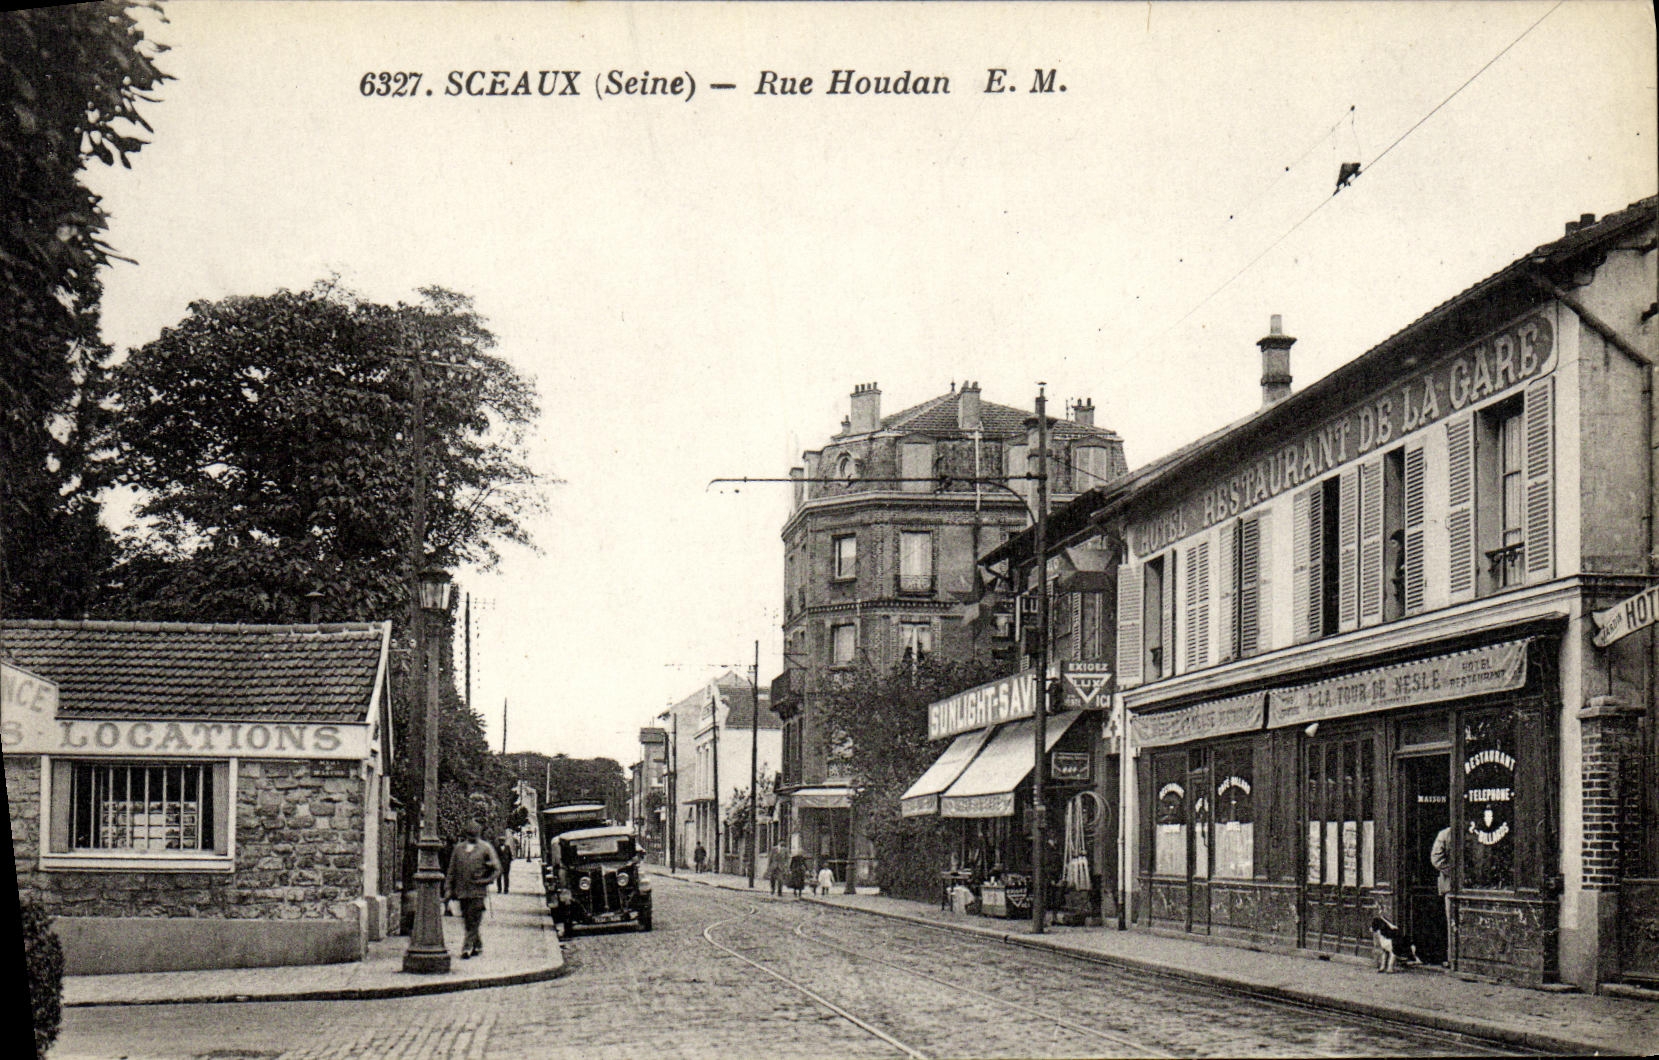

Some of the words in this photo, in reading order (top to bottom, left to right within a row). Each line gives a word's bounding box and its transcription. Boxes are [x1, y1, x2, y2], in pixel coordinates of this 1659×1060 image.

[1203, 423, 1351, 528] RESTAURANT
[1359, 395, 1393, 454] DE
[1401, 374, 1440, 432] LA
[1450, 321, 1539, 411] GARE
[1625, 588, 1659, 630] HOT
[1068, 663, 1109, 672] EXIGEZ
[1073, 679, 1101, 688] LUX
[1336, 682, 1367, 706] TOUR
[1392, 669, 1442, 695] NESLE
[1095, 694, 1111, 708] ICI
[59, 720, 342, 752] LOCATIONS
[1464, 750, 1516, 775] RESTAURANT
[1468, 788, 1511, 802] TELEPHONE
